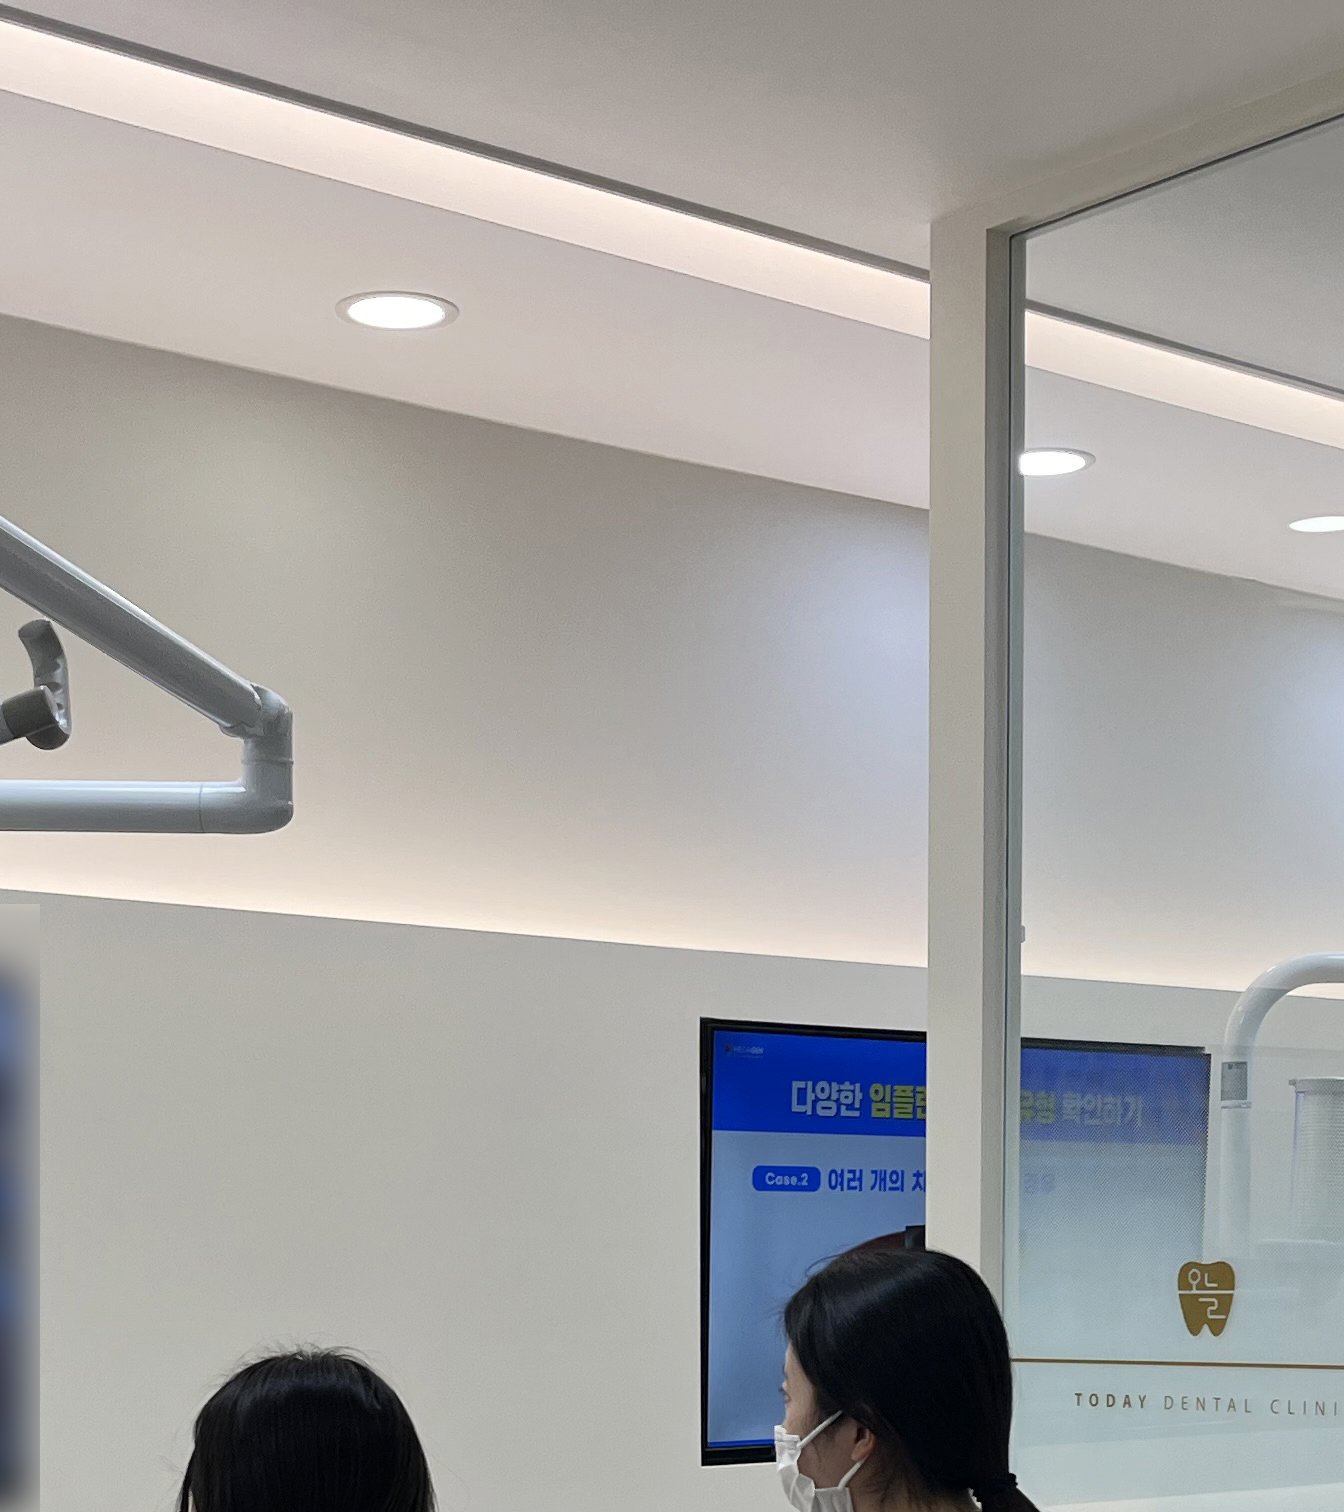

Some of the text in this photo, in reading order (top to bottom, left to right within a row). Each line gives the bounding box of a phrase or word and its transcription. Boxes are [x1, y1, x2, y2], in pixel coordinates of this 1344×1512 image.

[791, 1080, 863, 1117] 다양한
[1062, 1092, 1143, 1127] 확인하기
[765, 1172, 809, 1186] Case.2
[828, 1169, 864, 1192] 여러
[870, 1169, 905, 1192] 개의
[1074, 1392, 1147, 1409] TODAY
[1164, 1395, 1252, 1414] DENTAL
